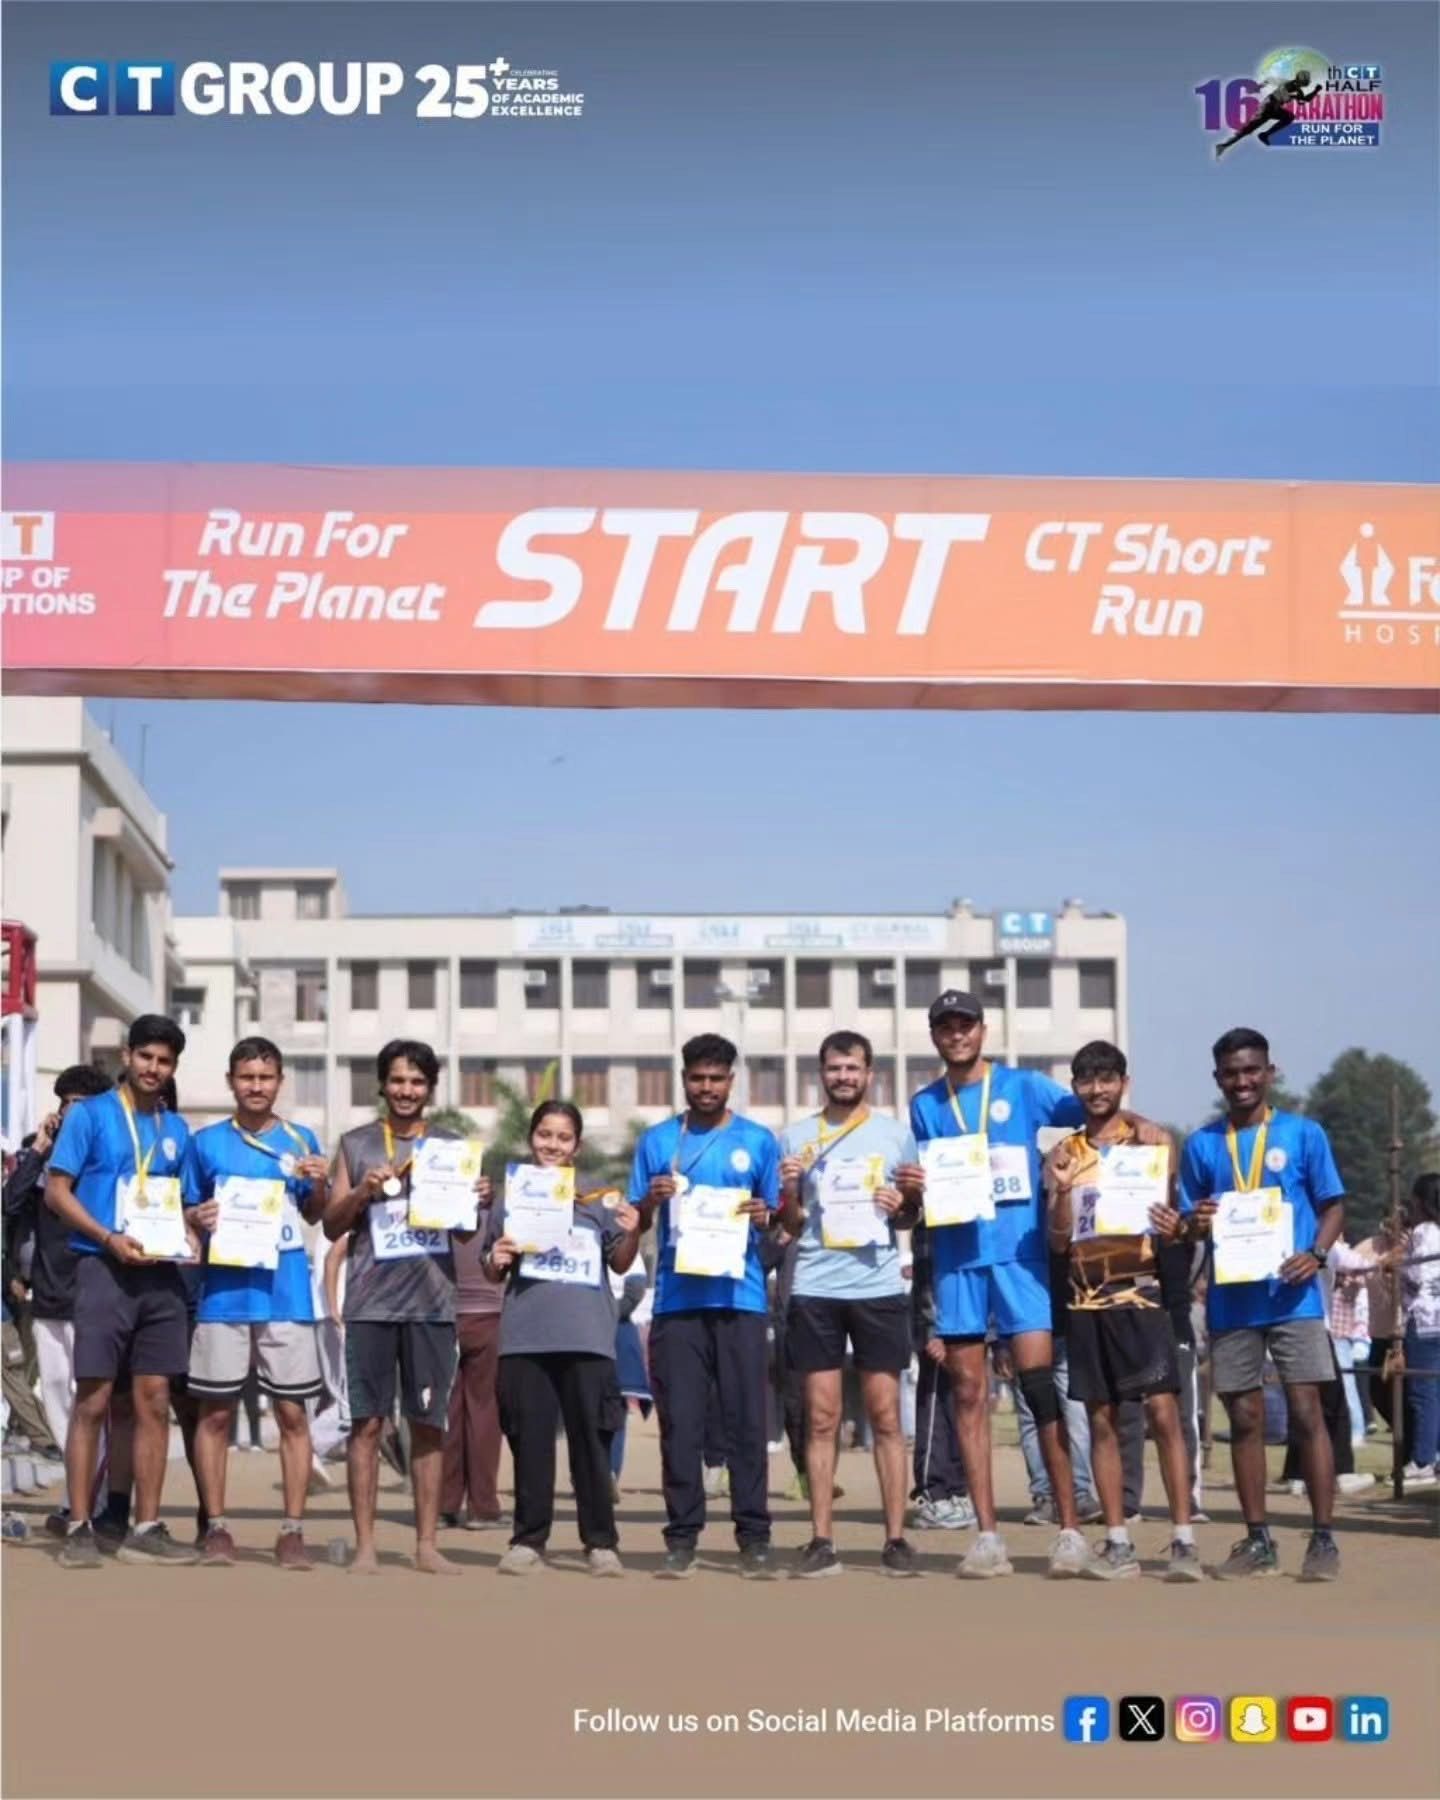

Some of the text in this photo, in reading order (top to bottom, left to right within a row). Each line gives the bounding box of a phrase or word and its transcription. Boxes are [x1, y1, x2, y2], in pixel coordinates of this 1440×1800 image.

[198, 509, 408, 559] Run For
[1025, 521, 1271, 576] CT Short
[32, 566, 71, 589] OF
[162, 570, 446, 621] The Planet
[472, 507, 991, 635] START
[1091, 584, 1204, 637] Run
[384, 1230, 441, 1249] 2692
[534, 1254, 592, 1276] 2691
